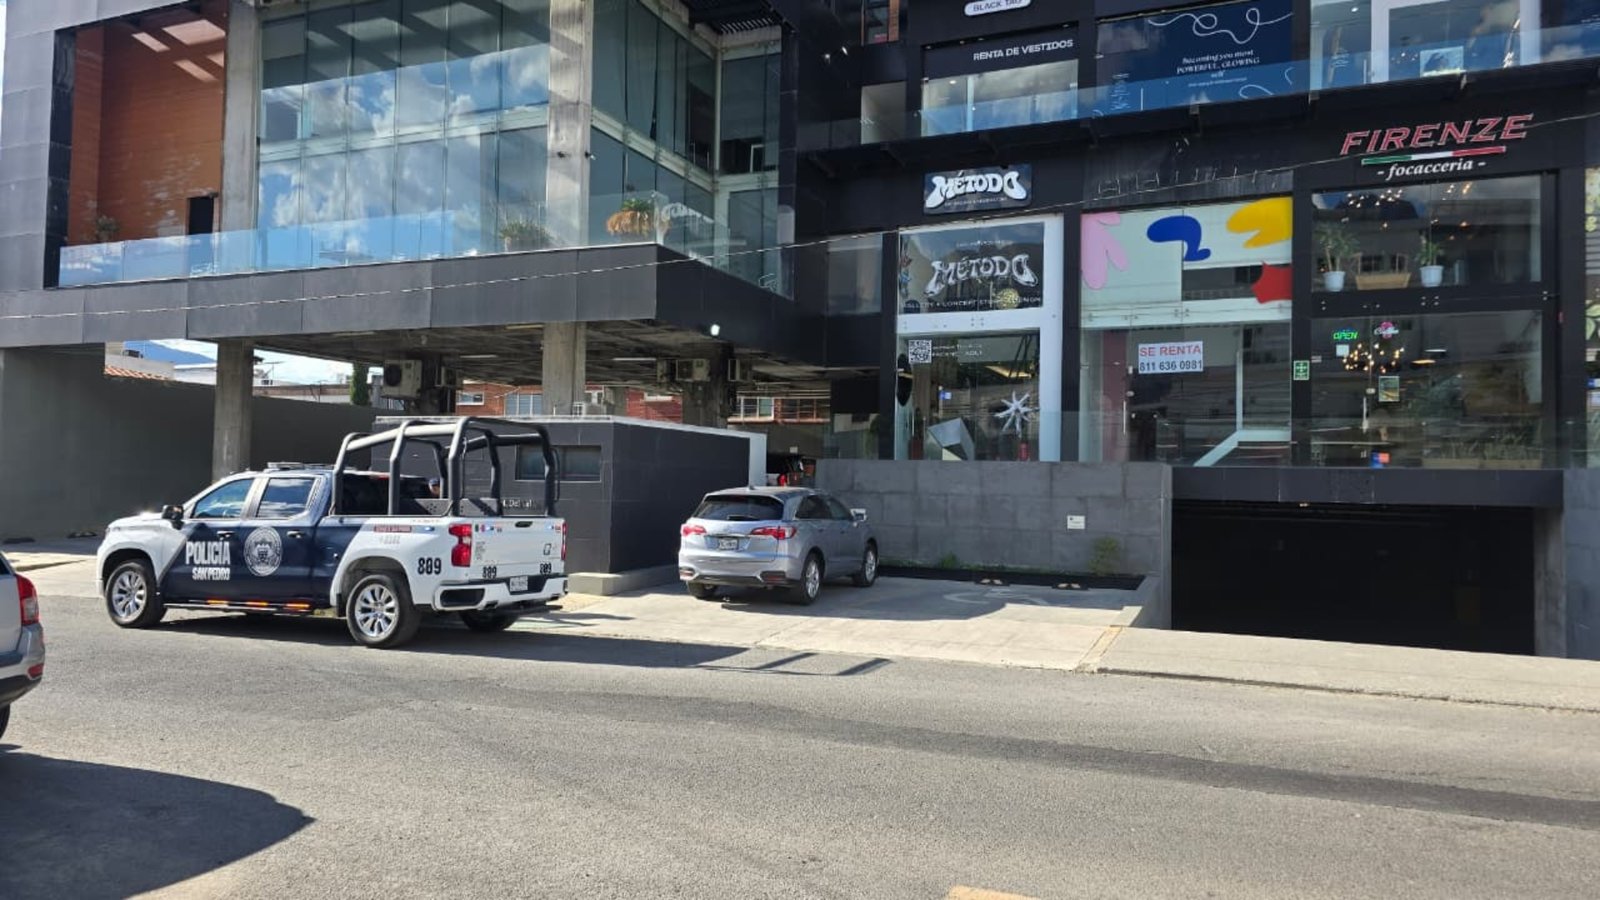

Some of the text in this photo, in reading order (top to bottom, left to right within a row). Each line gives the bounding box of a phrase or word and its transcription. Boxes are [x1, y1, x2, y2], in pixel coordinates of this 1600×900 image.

[973, 1, 1002, 12] BLACK
[973, 39, 1074, 61] RENTA DE VESTIDOS
[1221, 56, 1260, 69] GLOWING
[1340, 113, 1534, 156] FIRENZE
[925, 169, 1028, 208] MÉTODO
[923, 253, 1039, 297] MÉTODO
[1333, 330, 1359, 341] OPEN
[1140, 344, 1201, 357] SE RENTA
[1139, 359, 1202, 371] 811 636 0981
[185, 537, 231, 566] POLICÍA
[417, 556, 442, 576] 809
[482, 565, 498, 579] 809
[539, 562, 552, 575] 809
[192, 566, 231, 581] SAN PEDRO
